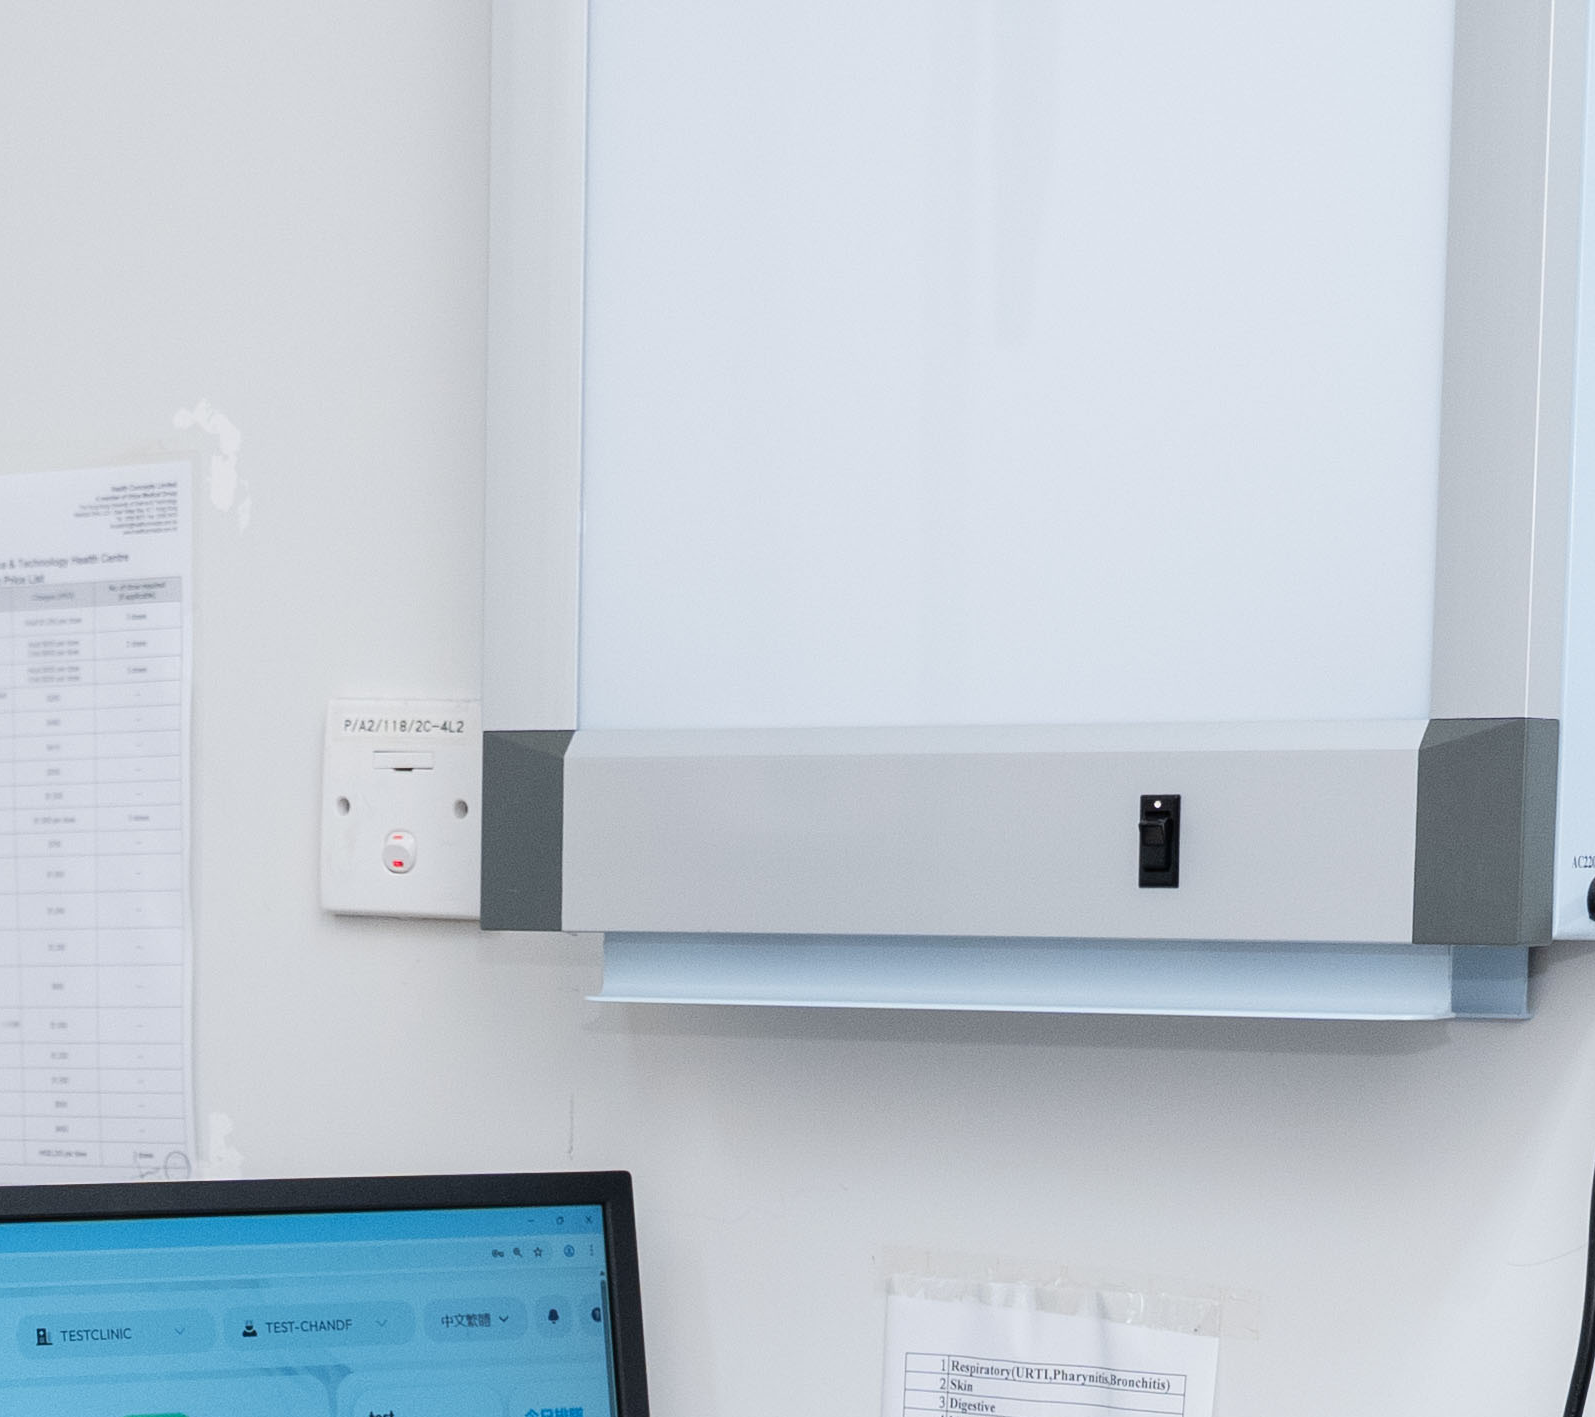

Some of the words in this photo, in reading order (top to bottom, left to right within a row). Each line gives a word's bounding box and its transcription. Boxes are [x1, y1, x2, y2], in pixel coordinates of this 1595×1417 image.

[344, 718, 464, 734] P/A2/118/2C-4L2
[60, 1327, 132, 1342] TESTCLINIC
[940, 1359, 946, 1372] 1
[939, 1378, 946, 1390] 2
[950, 1380, 973, 1392] Skin
[939, 1396, 946, 1409] 3
[950, 1398, 996, 1415] Digestive
